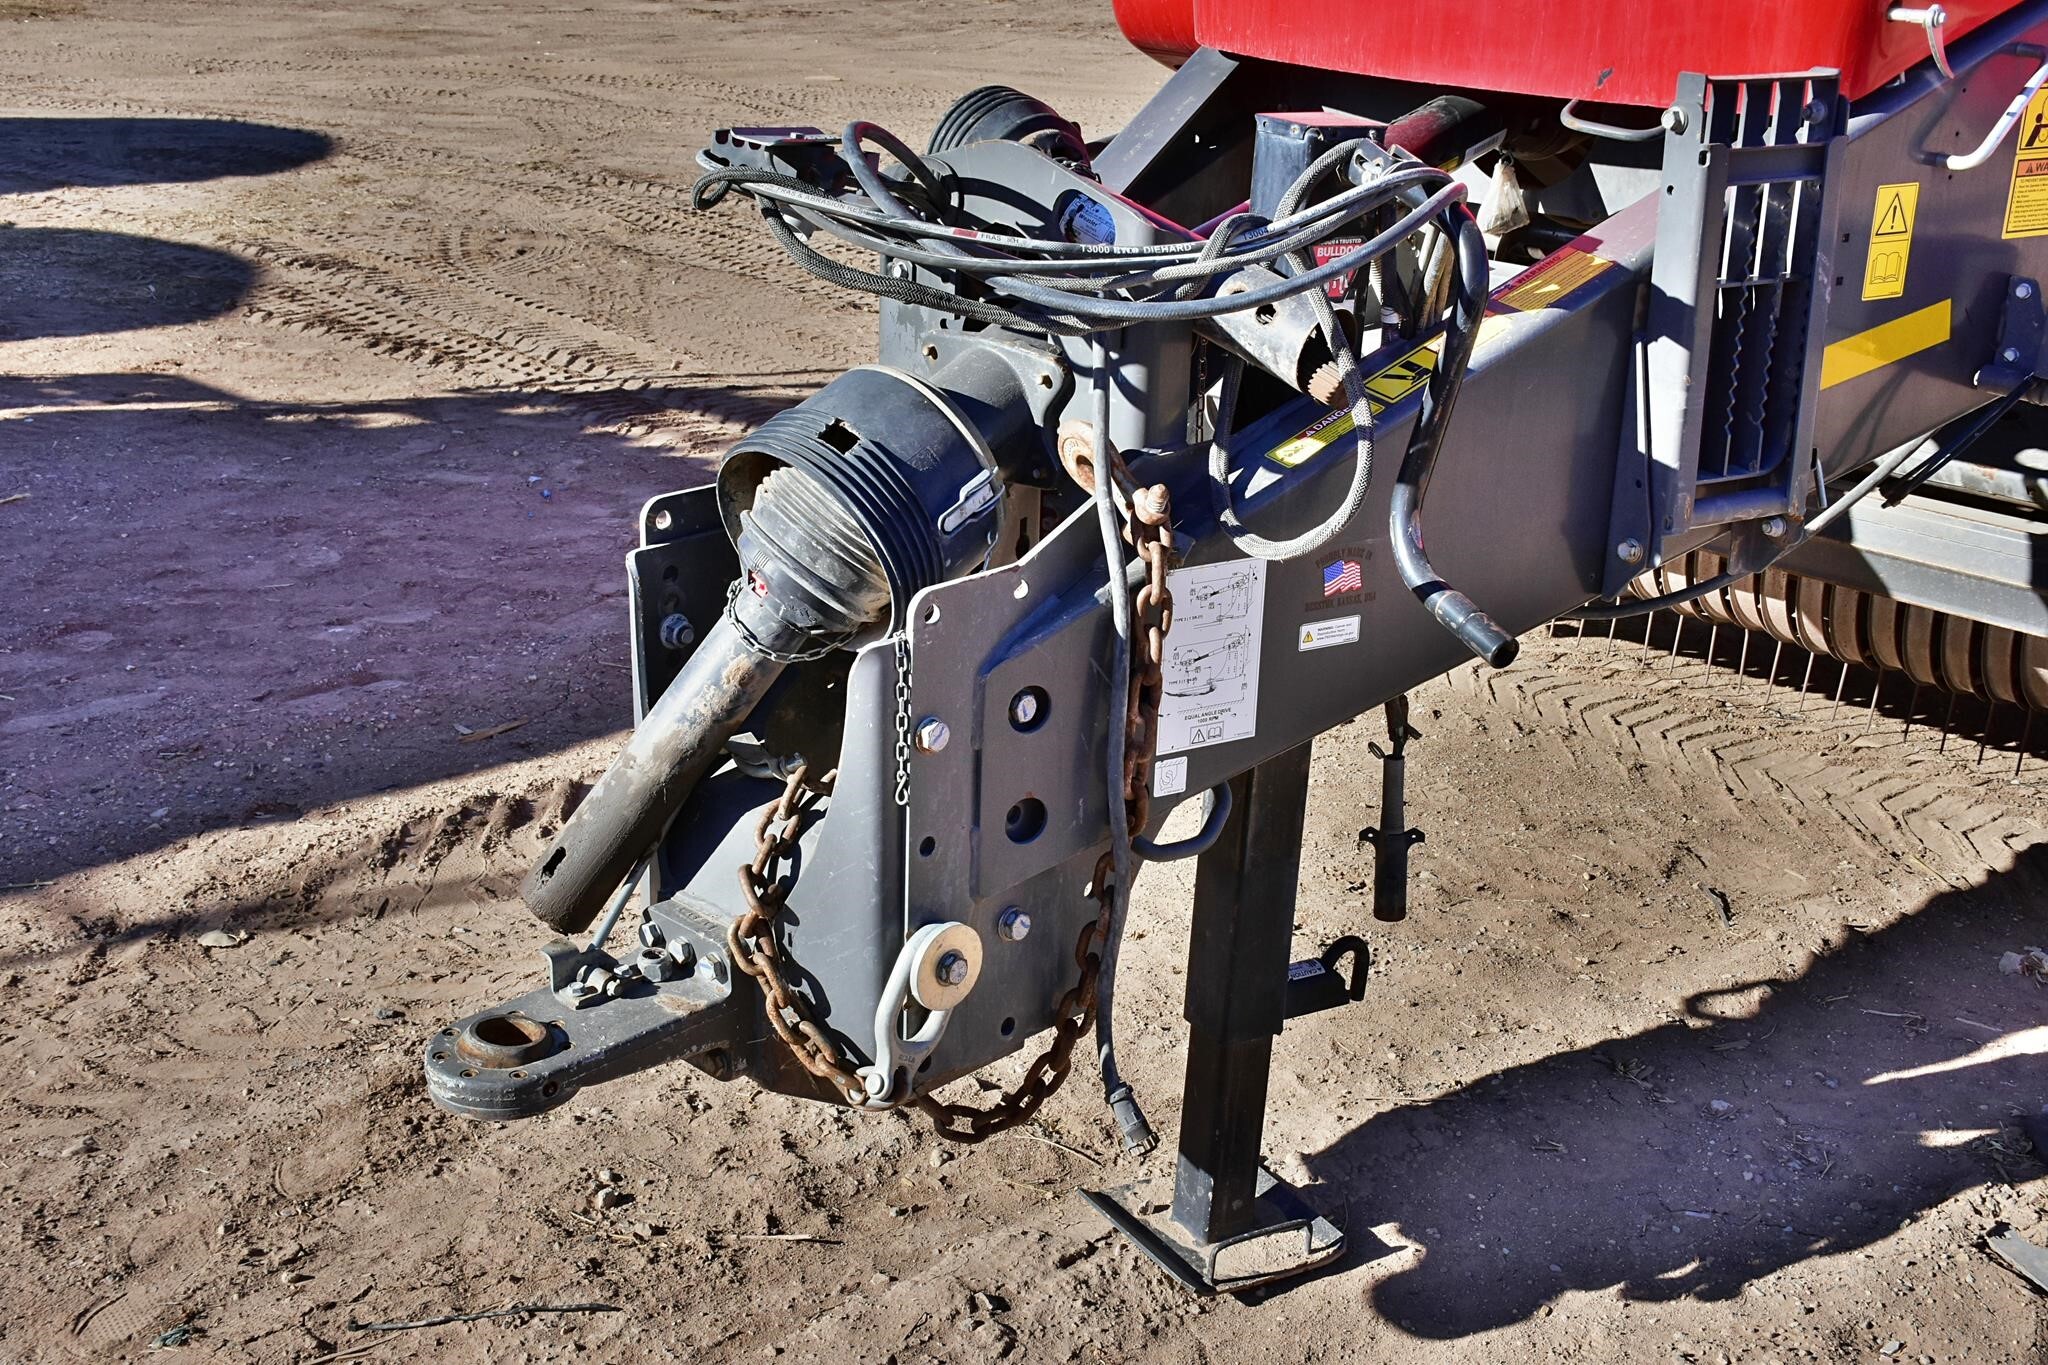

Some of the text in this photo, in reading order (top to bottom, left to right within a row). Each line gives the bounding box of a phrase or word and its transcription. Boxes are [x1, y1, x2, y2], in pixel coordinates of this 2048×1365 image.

[1081, 244, 1110, 254] T3000
[1143, 243, 1193, 254] DIEHARD
[1517, 256, 1561, 284] WARNING
[1313, 407, 1352, 430] DANGE
[1184, 707, 1232, 721] EQUAL ANGLE DRIVE
